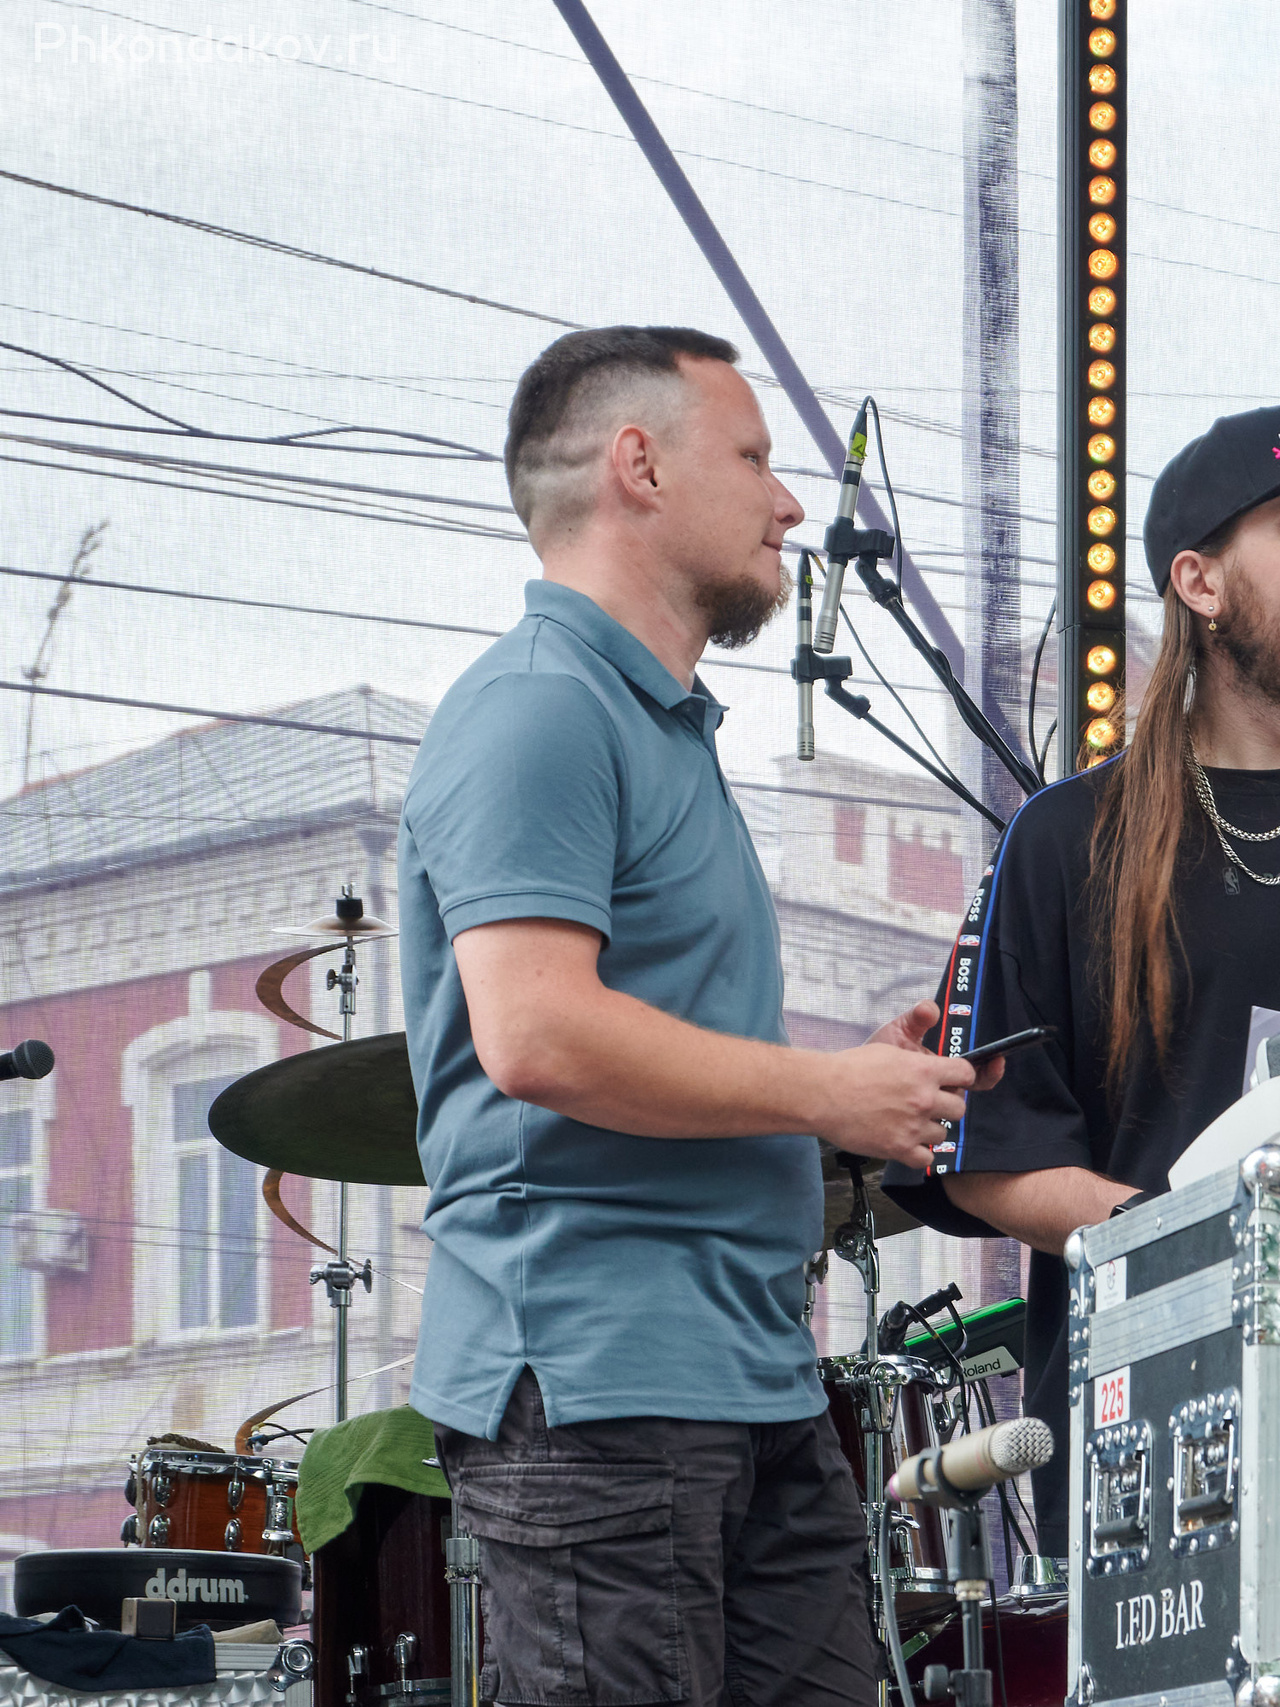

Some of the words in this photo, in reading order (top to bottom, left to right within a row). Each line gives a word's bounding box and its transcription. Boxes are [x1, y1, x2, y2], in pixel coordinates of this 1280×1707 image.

[968, 888, 985, 922] BOSS
[956, 957, 972, 992] BOSS
[1100, 1376, 1125, 1424] 225
[145, 1567, 245, 1604] ddrum
[1114, 1594, 1157, 1651] LED
[1161, 1579, 1206, 1640] BAR
